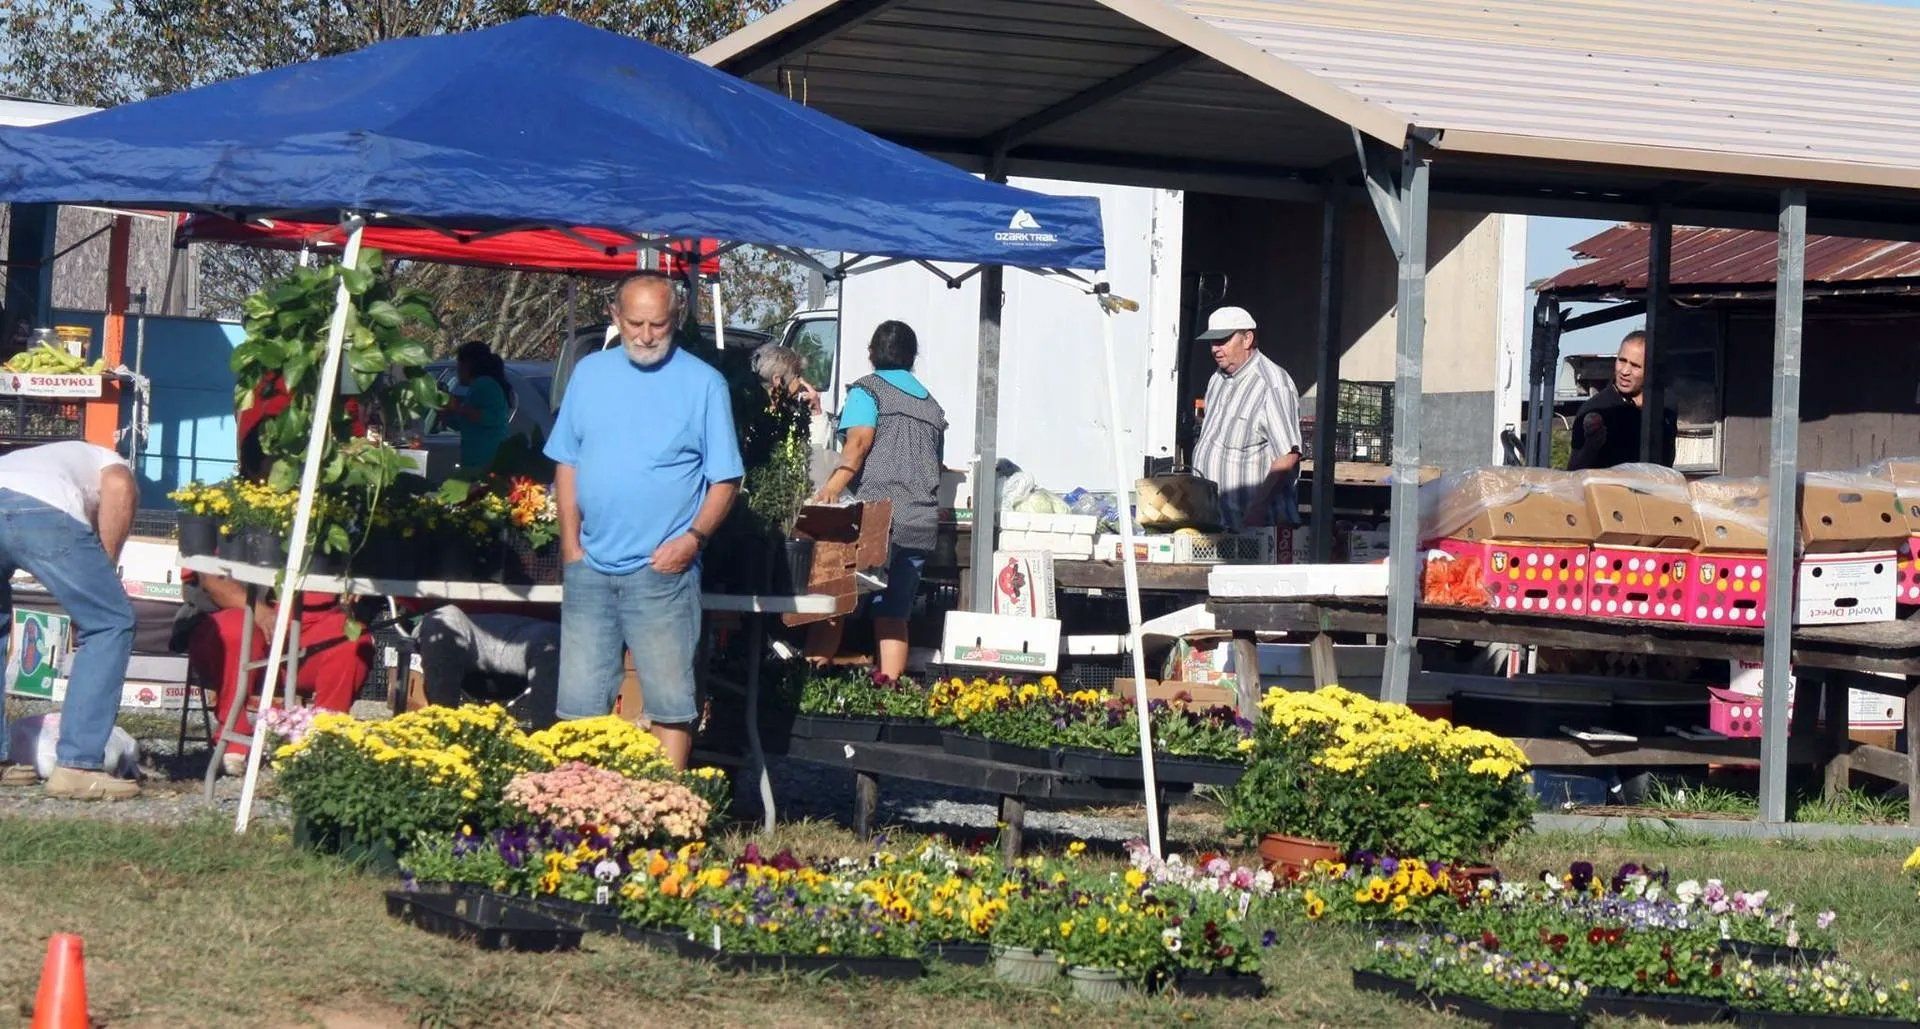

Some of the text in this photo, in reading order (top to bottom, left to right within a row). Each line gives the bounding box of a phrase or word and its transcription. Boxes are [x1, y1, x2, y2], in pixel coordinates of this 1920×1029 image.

[30, 376, 95, 387] TOMATOES
[1809, 606, 1883, 618] World Direct
